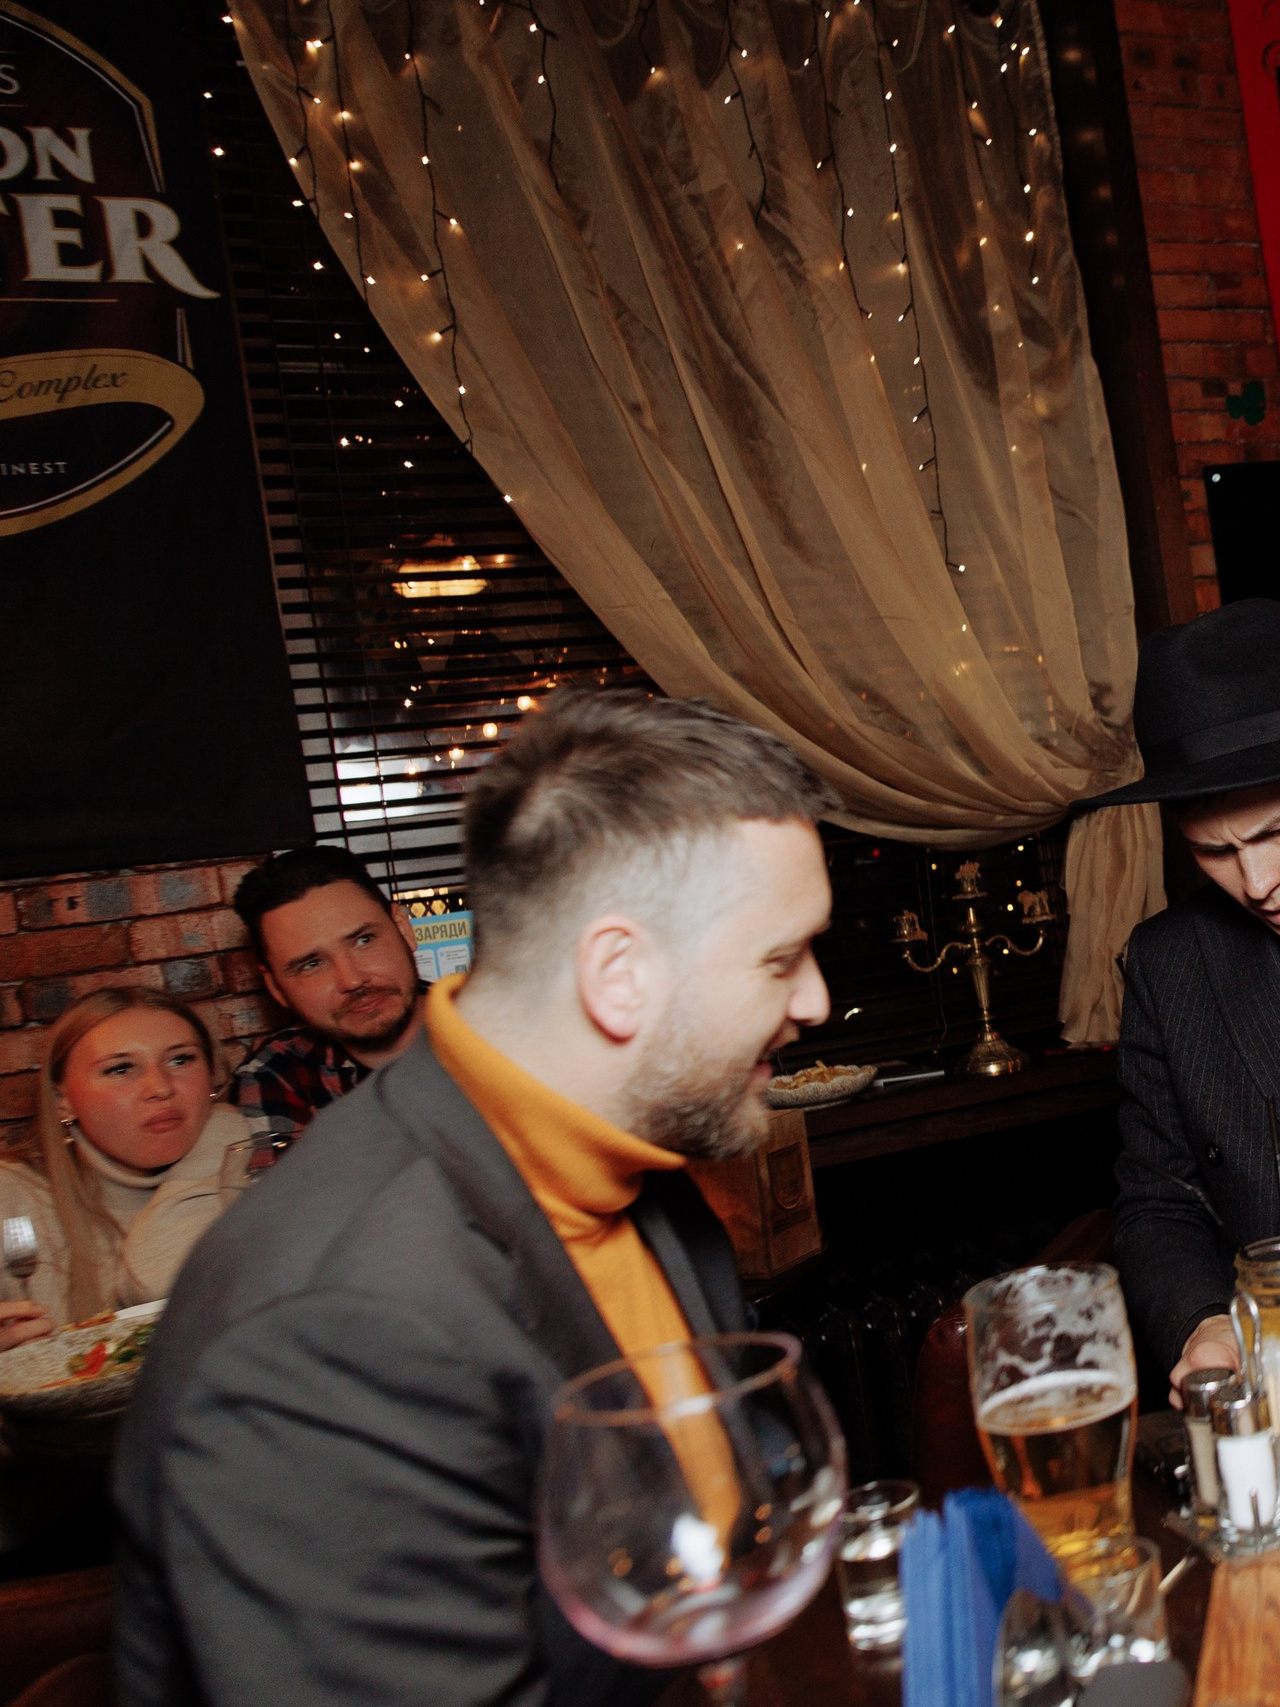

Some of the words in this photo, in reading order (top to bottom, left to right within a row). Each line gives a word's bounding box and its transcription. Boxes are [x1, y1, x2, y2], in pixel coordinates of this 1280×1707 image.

[0, 193, 221, 299] ER
[0, 363, 128, 403] Complex
[415, 921, 467, 941] ЗАРЯДИ
